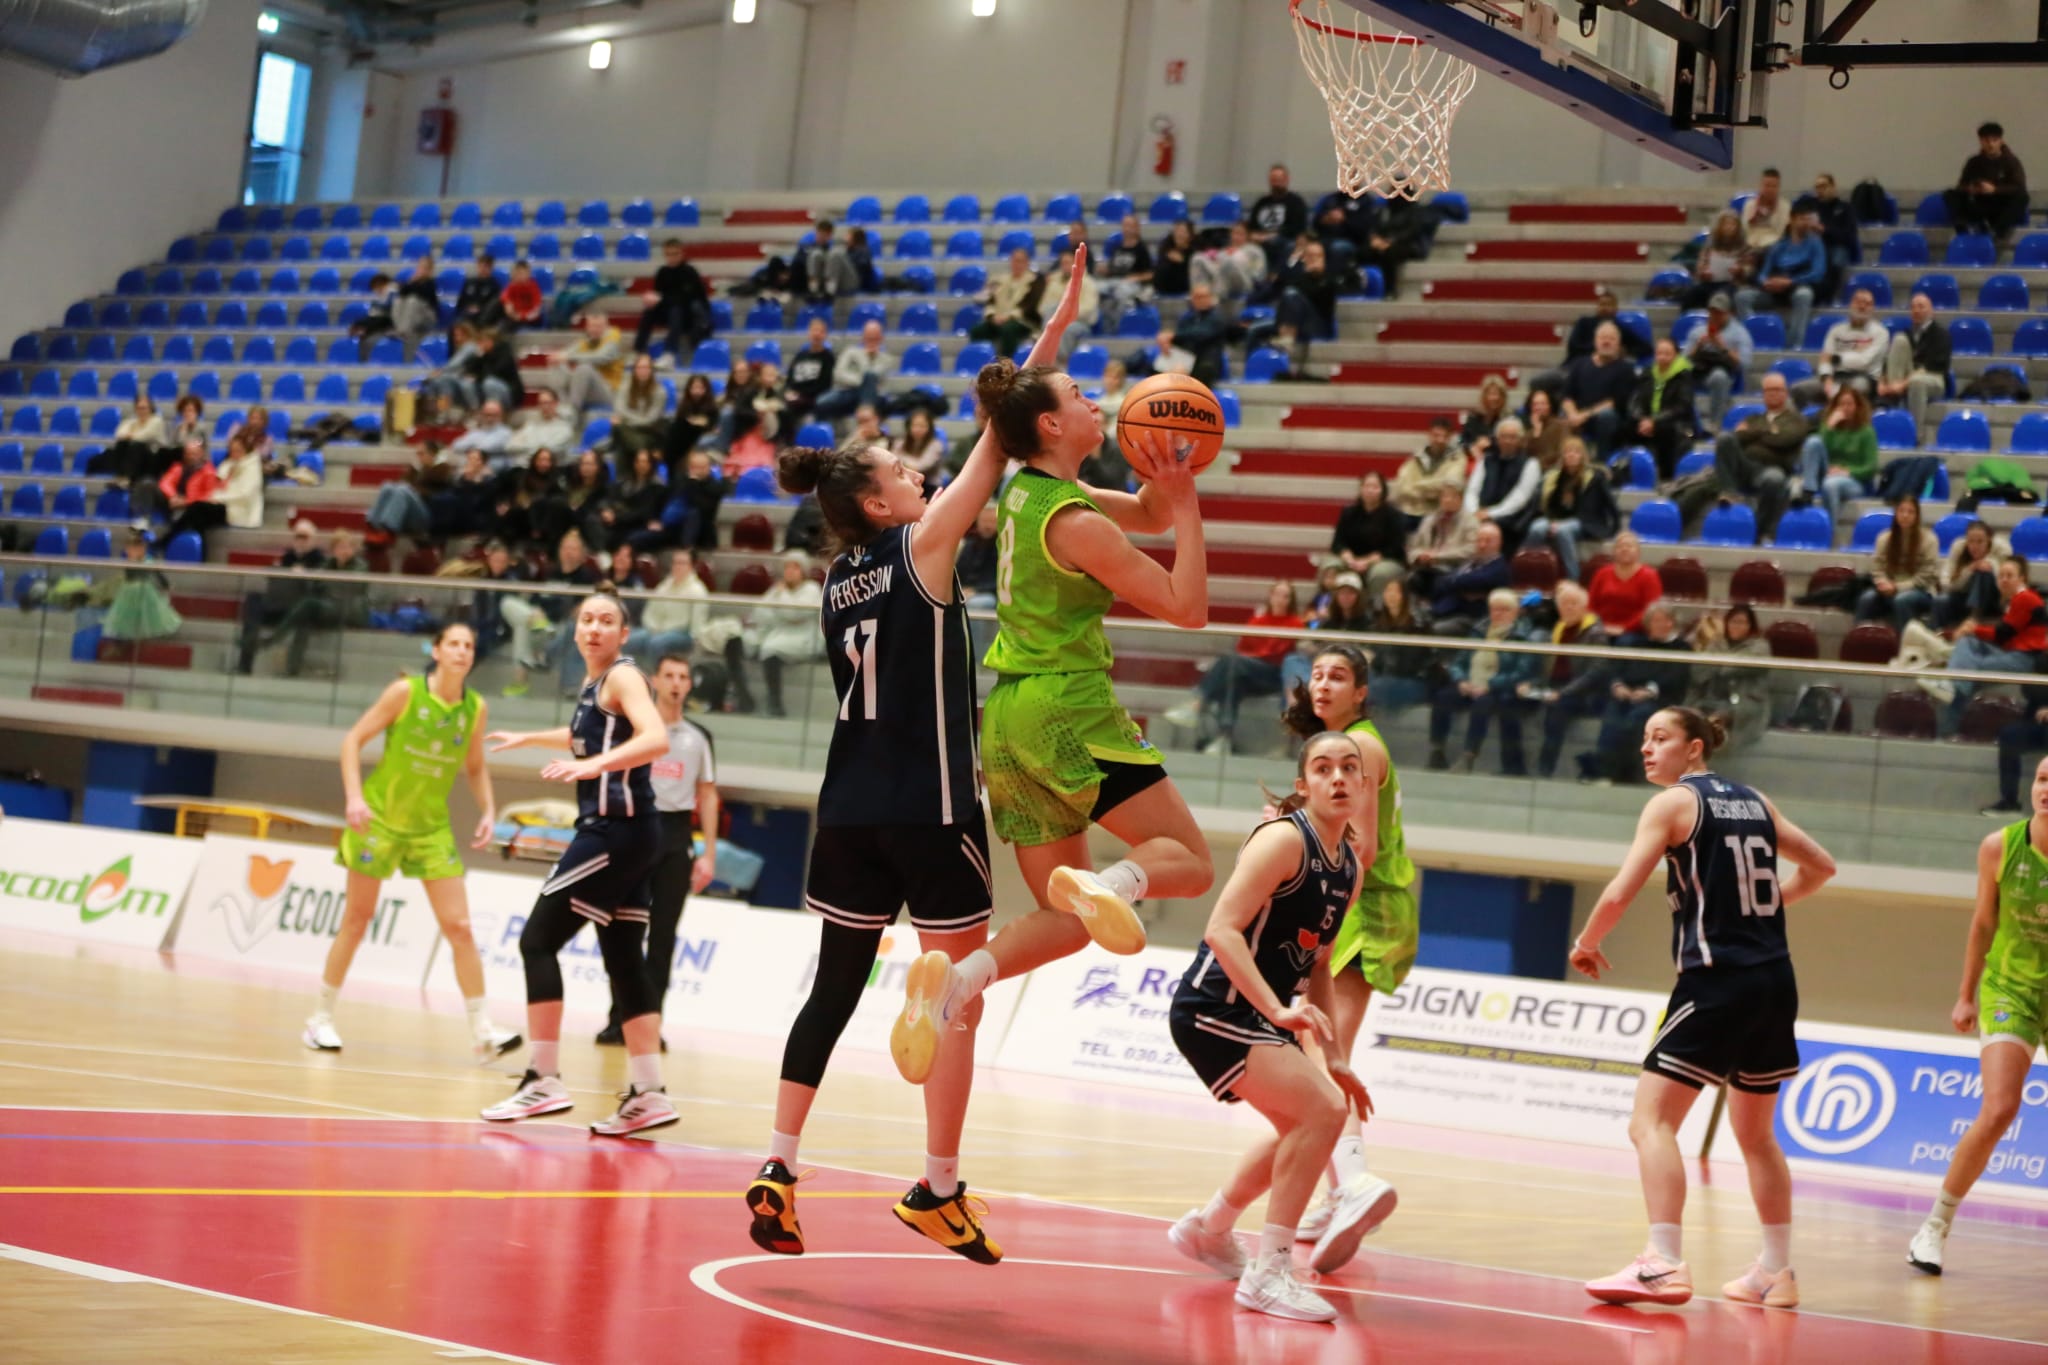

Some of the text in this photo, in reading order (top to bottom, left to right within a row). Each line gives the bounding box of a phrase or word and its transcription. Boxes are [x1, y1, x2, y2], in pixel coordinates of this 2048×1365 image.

[1147, 399, 1217, 426] Wilson
[1723, 834, 1781, 918] 16
[278, 884, 407, 946] ECODNT
[1951, 1116, 2023, 1142] mal
